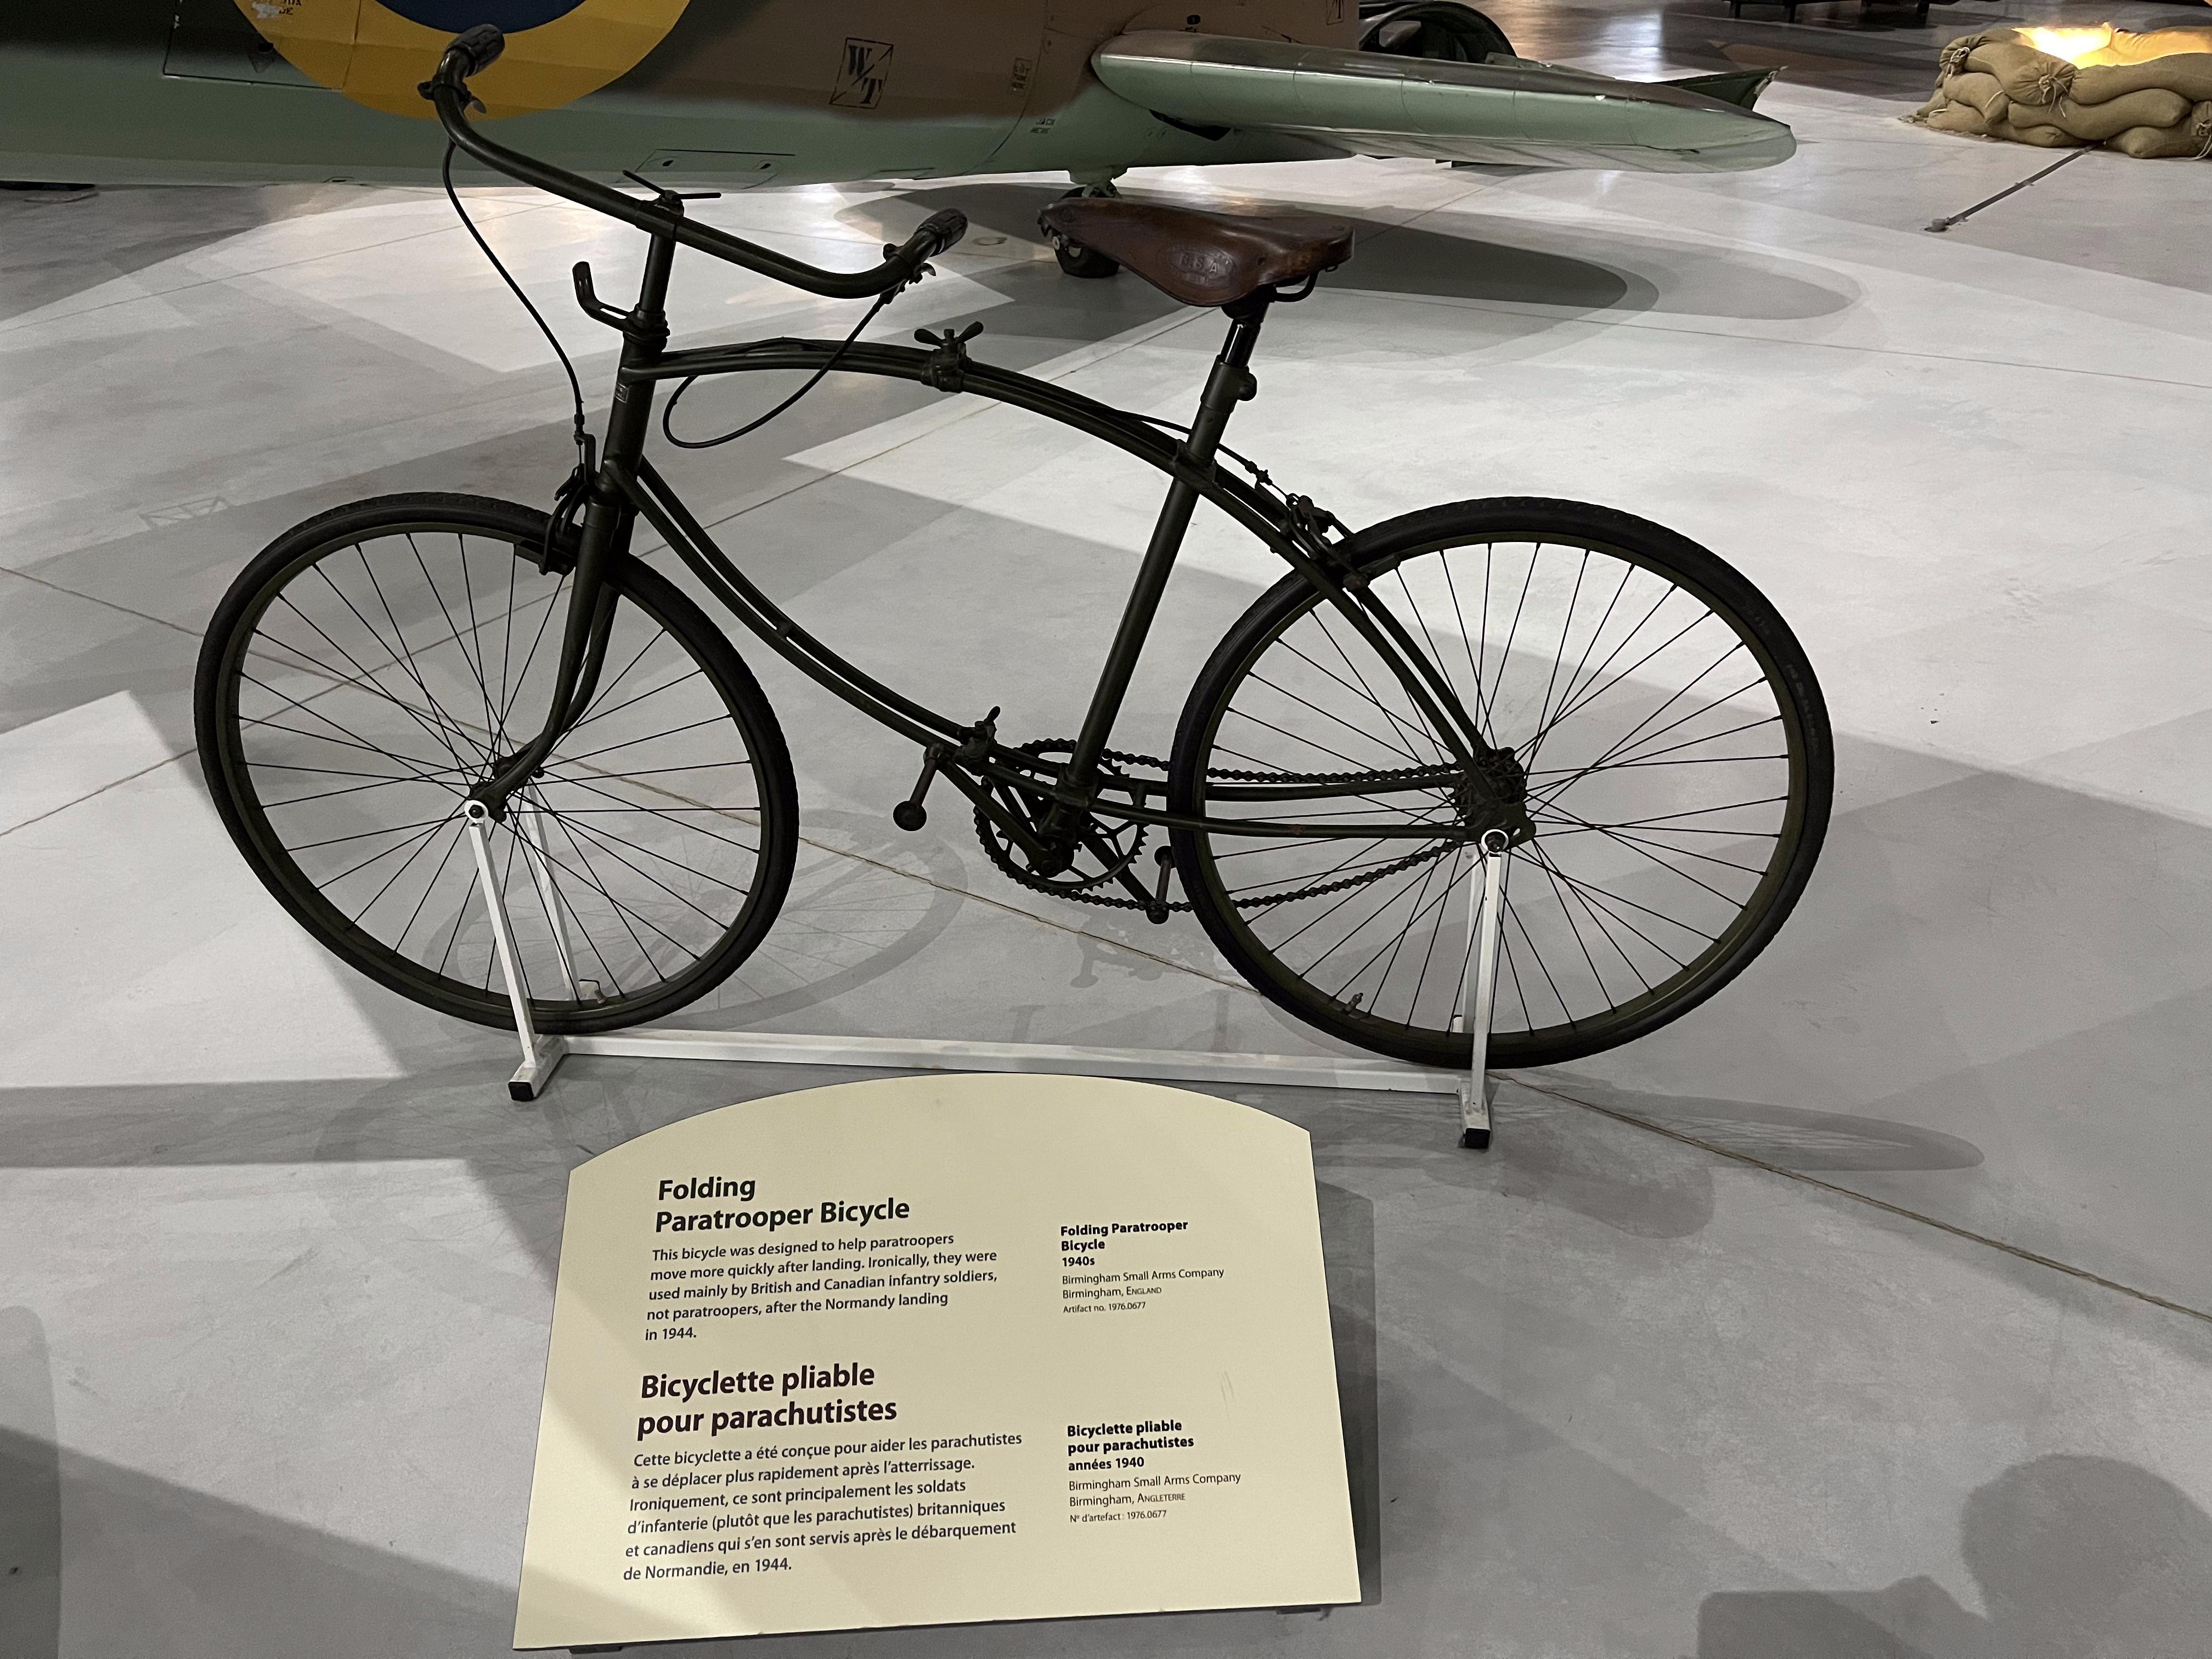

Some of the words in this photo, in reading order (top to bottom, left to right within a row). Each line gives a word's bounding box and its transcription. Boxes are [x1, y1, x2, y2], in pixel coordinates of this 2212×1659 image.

[658, 1176, 756, 1202] Folding
[656, 1207, 814, 1233] Paratrooper
[820, 1197, 910, 1228] Bicycle
[1061, 1224, 1108, 1237] Folding
[1112, 1222, 1188, 1233] Paratrooper
[652, 1249, 678, 1261] This
[681, 1245, 726, 1262] bicycle
[730, 1246, 755, 1257] was
[758, 1239, 818, 1257] designed
[821, 1241, 835, 1251] to
[838, 1237, 867, 1252] help
[870, 1235, 954, 1252] paratroopers
[1062, 1239, 1105, 1252] Bicycle
[650, 1270, 687, 1281] move
[690, 1268, 724, 1279] more
[727, 1262, 775, 1279] quickly
[777, 1260, 809, 1273] after
[812, 1257, 865, 1272] landing.
[868, 1253, 930, 1268] Ironically,
[933, 1251, 963, 1266] they
[965, 1252, 997, 1262] were
[1062, 1256, 1095, 1267] 1940s
[649, 1286, 680, 1301] used
[684, 1284, 729, 1300] mainly
[731, 1283, 748, 1299] by
[751, 1280, 792, 1295] British
[795, 1278, 821, 1292] and
[823, 1276, 885, 1290] Canadian
[889, 1273, 940, 1287] infantry
[943, 1269, 997, 1284] soldiers,
[1063, 1273, 1120, 1285] Birmingham
[1124, 1271, 1148, 1281] Small
[1152, 1271, 1176, 1280] Arms
[1178, 1269, 1224, 1279] Company
[1063, 1288, 1124, 1299] Birmingham,
[1126, 1286, 1161, 1295] ENGLAND
[647, 1308, 670, 1321] not
[673, 1305, 762, 1323] paratroopers,
[765, 1300, 797, 1314] after
[800, 1299, 822, 1312] the
[825, 1294, 895, 1310] Normandy
[899, 1292, 948, 1307] landing
[1063, 1305, 1091, 1313] Artifact
[1109, 1301, 1146, 1311] 1976.0677
[645, 1328, 657, 1341] in
[662, 1327, 697, 1340] 1944.
[641, 1369, 775, 1403] Bicyclette
[782, 1362, 875, 1397] pliable
[637, 1413, 704, 1442] pour
[711, 1398, 897, 1437] parachutistes
[1068, 1423, 1133, 1439] Bicyclette
[1136, 1419, 1182, 1436] pliable
[634, 1454, 670, 1467] Cette
[674, 1449, 741, 1467] bicyclette
[744, 1450, 752, 1460] a
[756, 1444, 778, 1459] été
[781, 1446, 831, 1460] conçue
[834, 1443, 867, 1458] pour
[870, 1438, 906, 1453] aider
[909, 1437, 927, 1451] les
[931, 1432, 1022, 1453] parachutistes
[1068, 1443, 1099, 1457] pour
[1103, 1436, 1194, 1454] parachutistes
[631, 1475, 640, 1489] à
[643, 1478, 658, 1489] se
[662, 1471, 723, 1490] déplacer
[725, 1469, 754, 1487] plus
[758, 1465, 839, 1484] rapidement
[842, 1461, 880, 1480] après
[884, 1458, 975, 1474] l'atterrissage.
[1069, 1458, 1111, 1471] années
[1115, 1457, 1144, 1468] 1940
[1069, 1479, 1130, 1491] Birmingham
[1134, 1476, 1160, 1487] Small
[1164, 1476, 1189, 1485] Arms
[1193, 1474, 1241, 1485] Company
[630, 1494, 729, 1513] Ironiquement,
[732, 1494, 748, 1505] ce
[751, 1490, 782, 1504] sont
[785, 1484, 891, 1505] principalement
[895, 1481, 913, 1496] les
[917, 1479, 966, 1494] soldats
[1070, 1494, 1134, 1508] Birmingham,
[1137, 1493, 1186, 1503] ANGLETERRE
[628, 1516, 708, 1534] d'infanterie
[712, 1513, 760, 1532] (plutôt
[763, 1514, 790, 1529] que
[793, 1509, 812, 1524] les
[816, 1503, 913, 1526] parachutistes)
[917, 1500, 1006, 1516] britanniques
[1127, 1510, 1166, 1519] 1976.0677
[625, 1545, 640, 1558] et
[643, 1539, 714, 1556] canadiens
[718, 1536, 741, 1555] qui
[744, 1536, 771, 1550] s'en
[775, 1534, 806, 1548] sont
[809, 1530, 850, 1545] servis
[853, 1527, 891, 1546] après
[895, 1526, 908, 1541] le
[911, 1521, 1017, 1541] débarquement
[623, 1566, 641, 1581] de
[645, 1561, 728, 1579] Normandie,
[732, 1562, 750, 1573] en
[755, 1557, 792, 1572] 1944.
